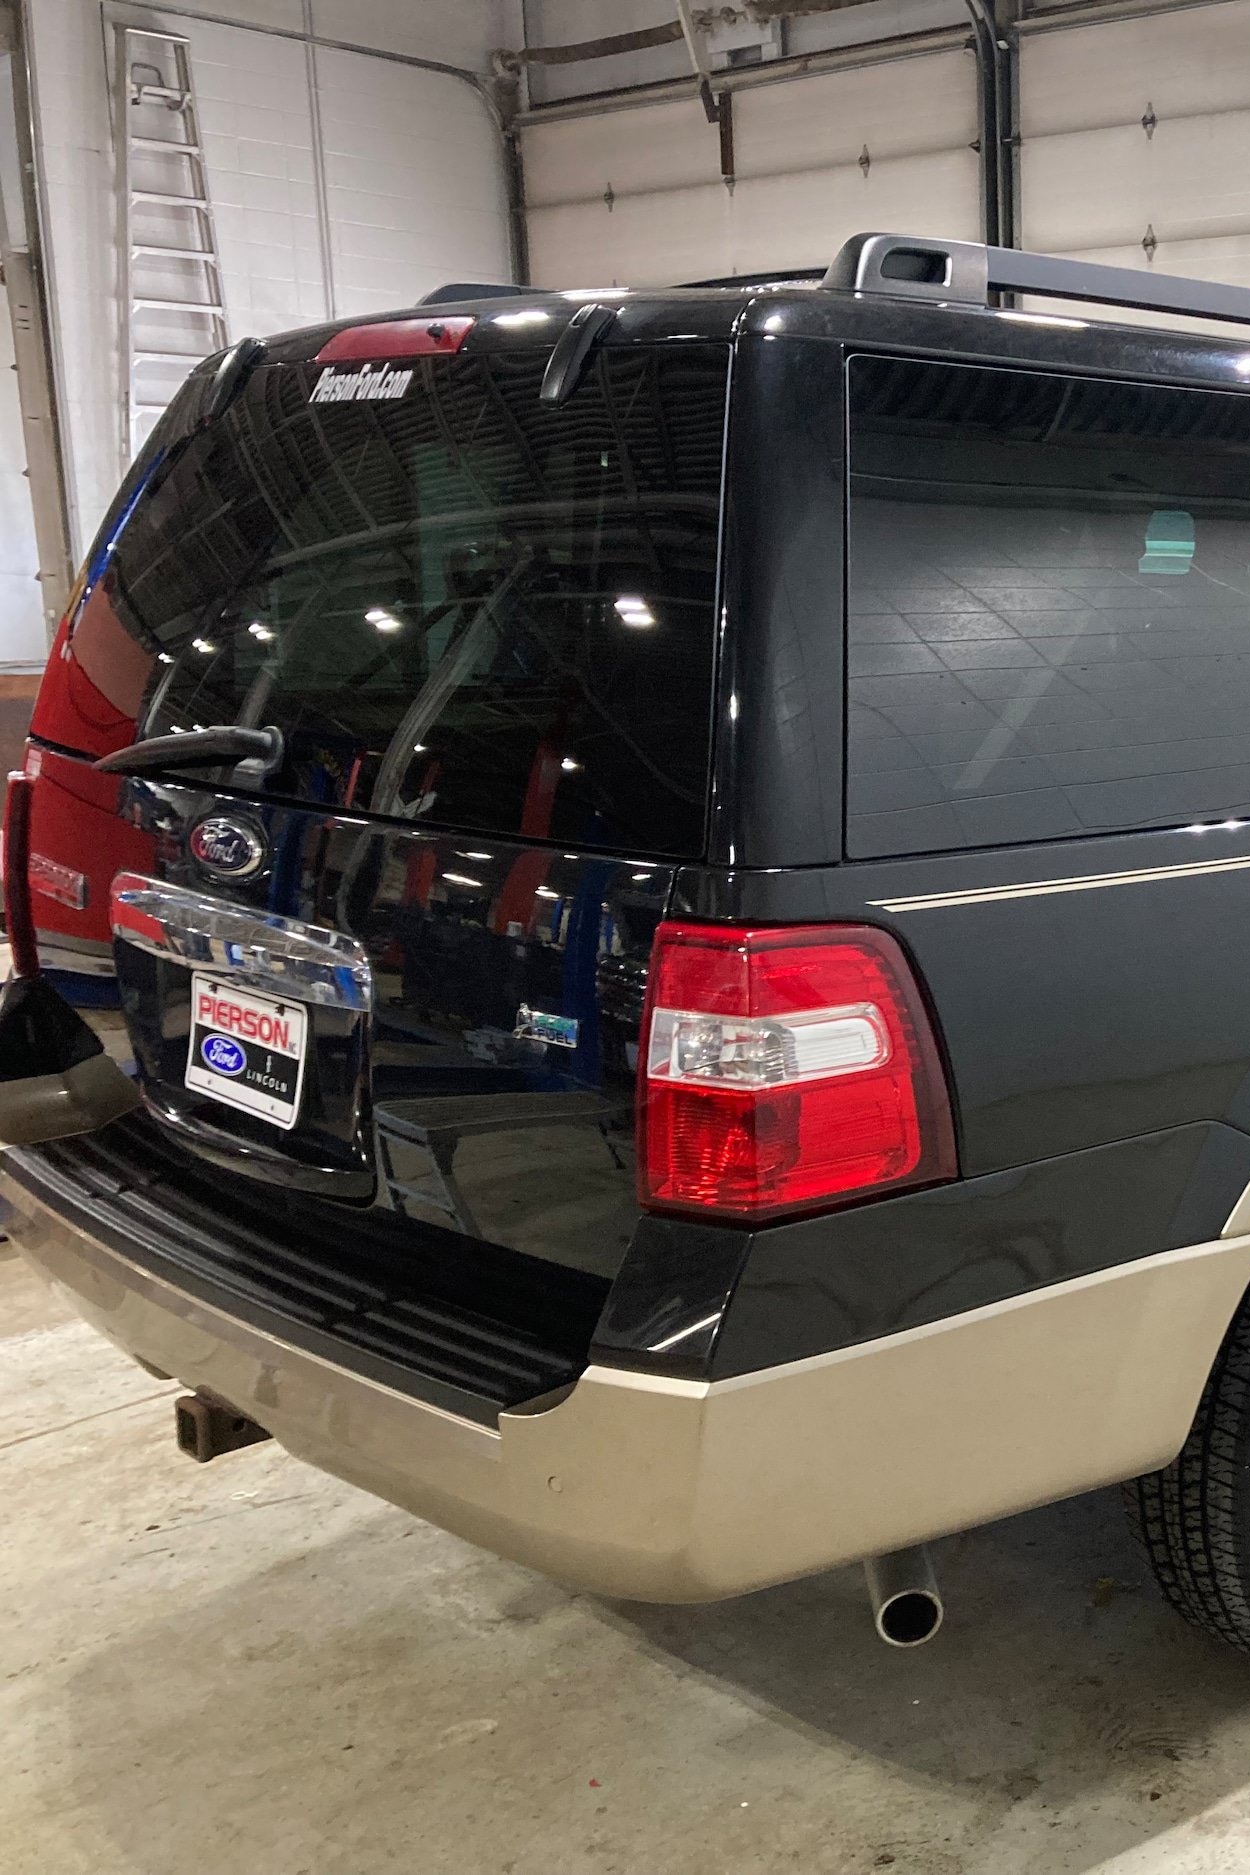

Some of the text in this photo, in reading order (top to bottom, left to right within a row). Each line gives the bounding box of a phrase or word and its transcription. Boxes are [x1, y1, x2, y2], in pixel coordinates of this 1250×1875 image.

[200, 826, 240, 862] Ford
[198, 992, 290, 1050] PIERSON
[208, 1039, 240, 1069] Ford
[246, 1068, 288, 1093] LINCOLN
